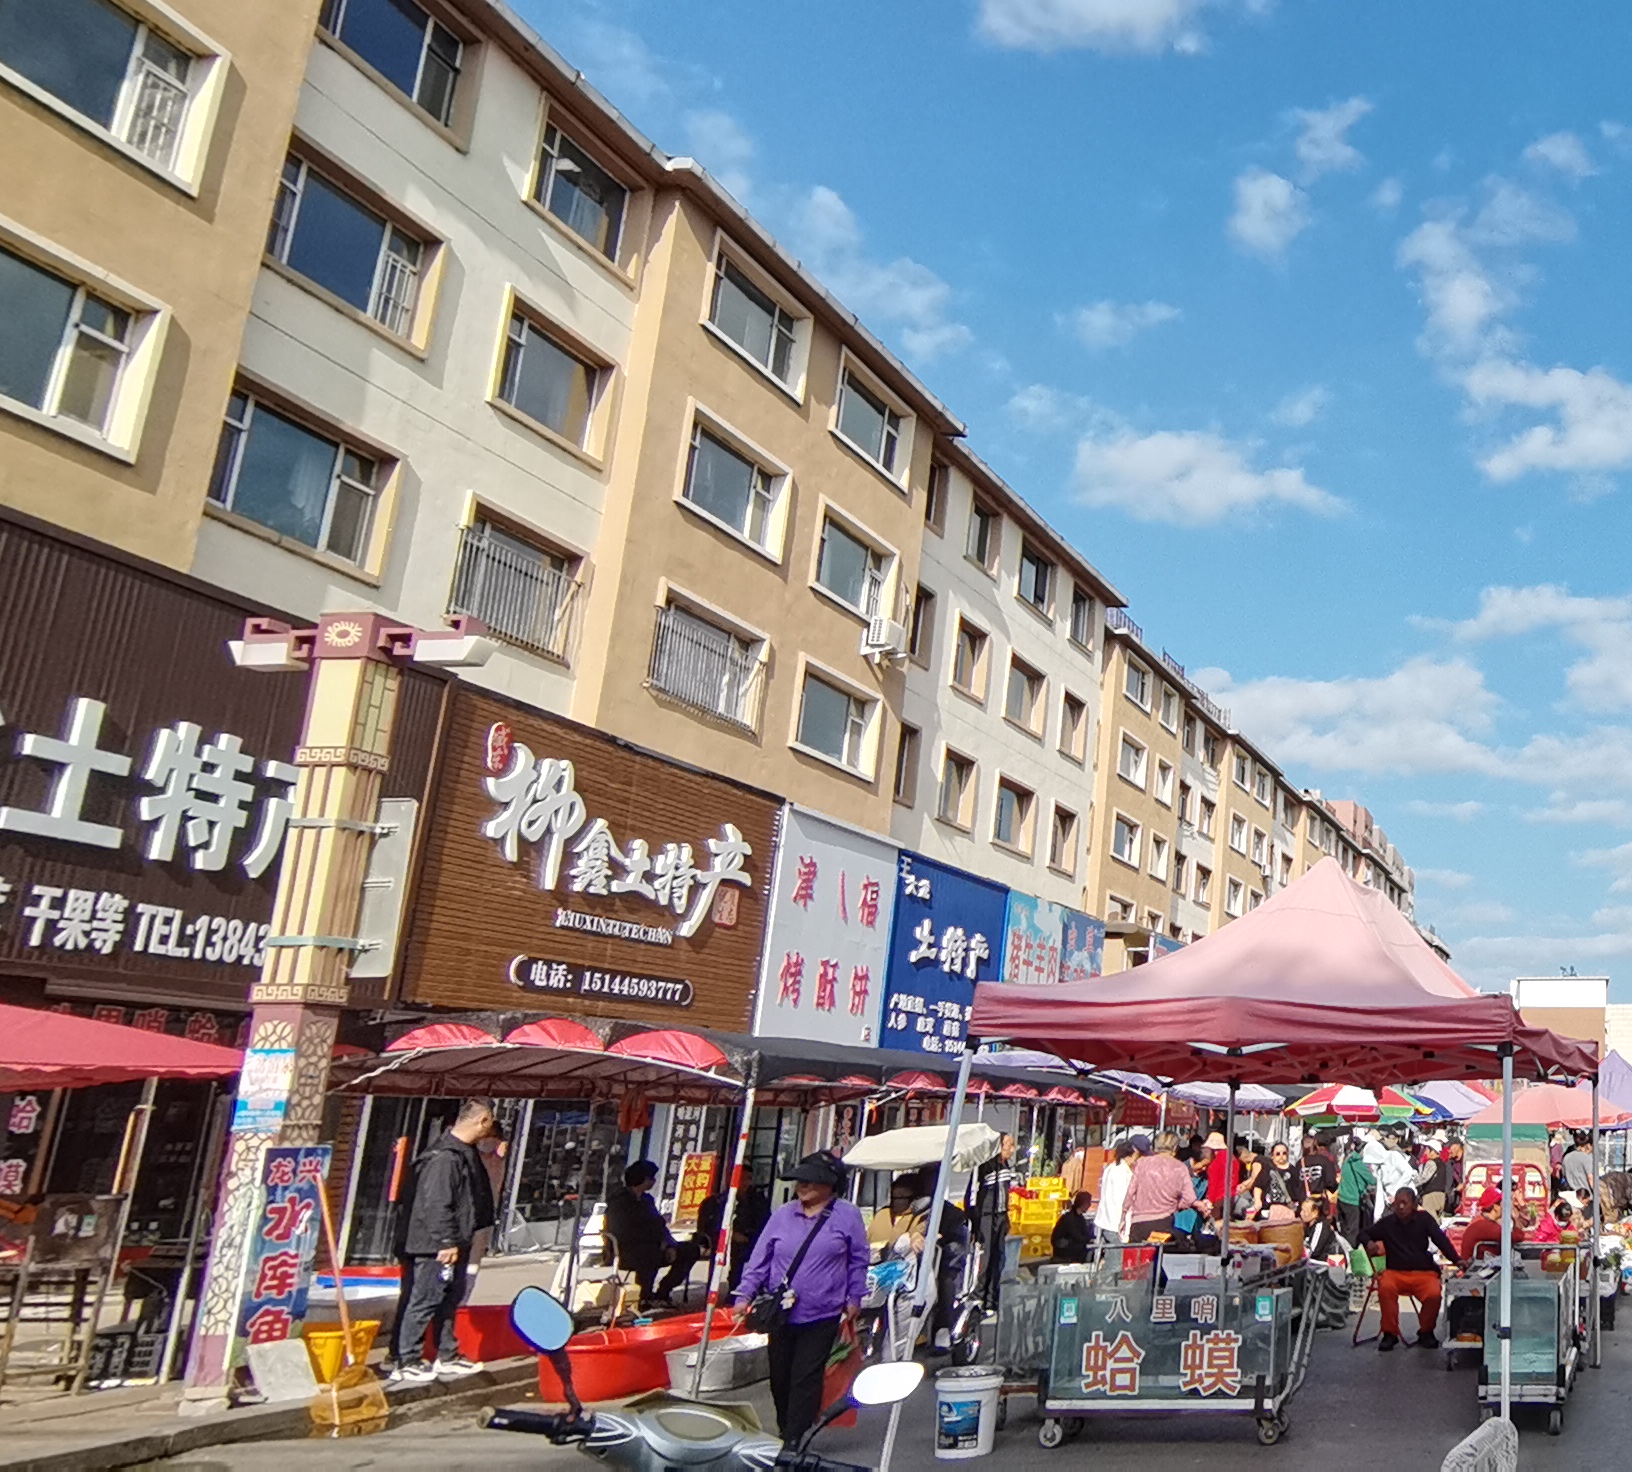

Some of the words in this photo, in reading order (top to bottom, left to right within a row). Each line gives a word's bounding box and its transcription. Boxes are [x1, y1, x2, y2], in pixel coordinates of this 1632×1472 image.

[484, 742, 753, 938] 柳鑫土特产
[23, 884, 129, 954] 干果等
[909, 918, 990, 980] 土特产
[581, 970, 684, 1002] 15144593777
[776, 950, 870, 1017] 烤酥饼
[266, 1156, 325, 1186] 龙兴
[247, 1196, 313, 1344] 水库鱼
[1105, 1295, 1218, 1324] 八里哨
[1081, 1330, 1243, 1397] 蛤蟆
